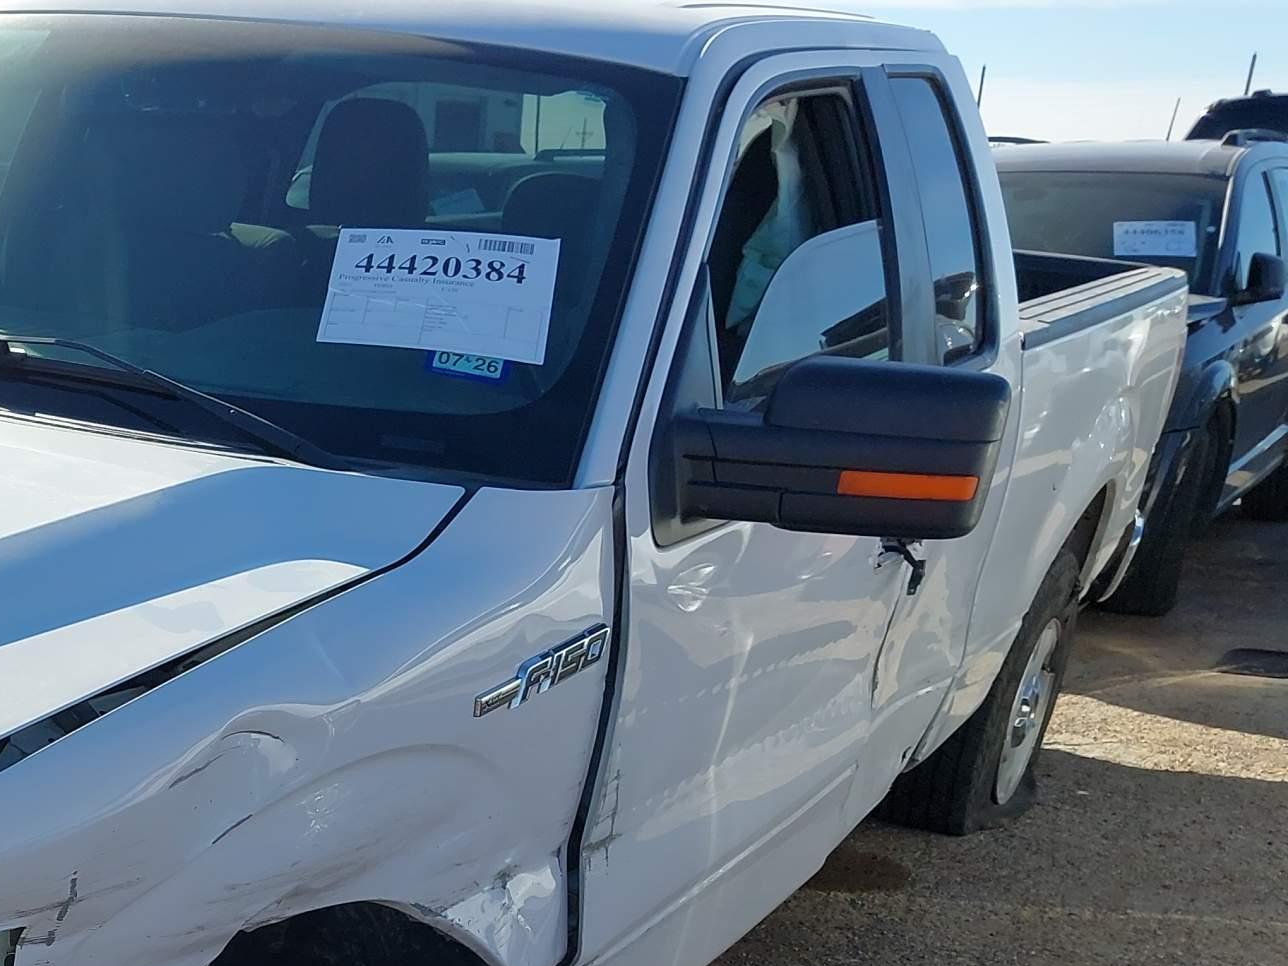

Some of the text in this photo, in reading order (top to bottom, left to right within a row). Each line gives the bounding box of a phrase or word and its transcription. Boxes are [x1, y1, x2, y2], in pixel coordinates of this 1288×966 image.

[339, 273, 475, 287] Progressive Casualty Insurance
[354, 253, 527, 284] 44420384
[438, 351, 499, 374] 07 26
